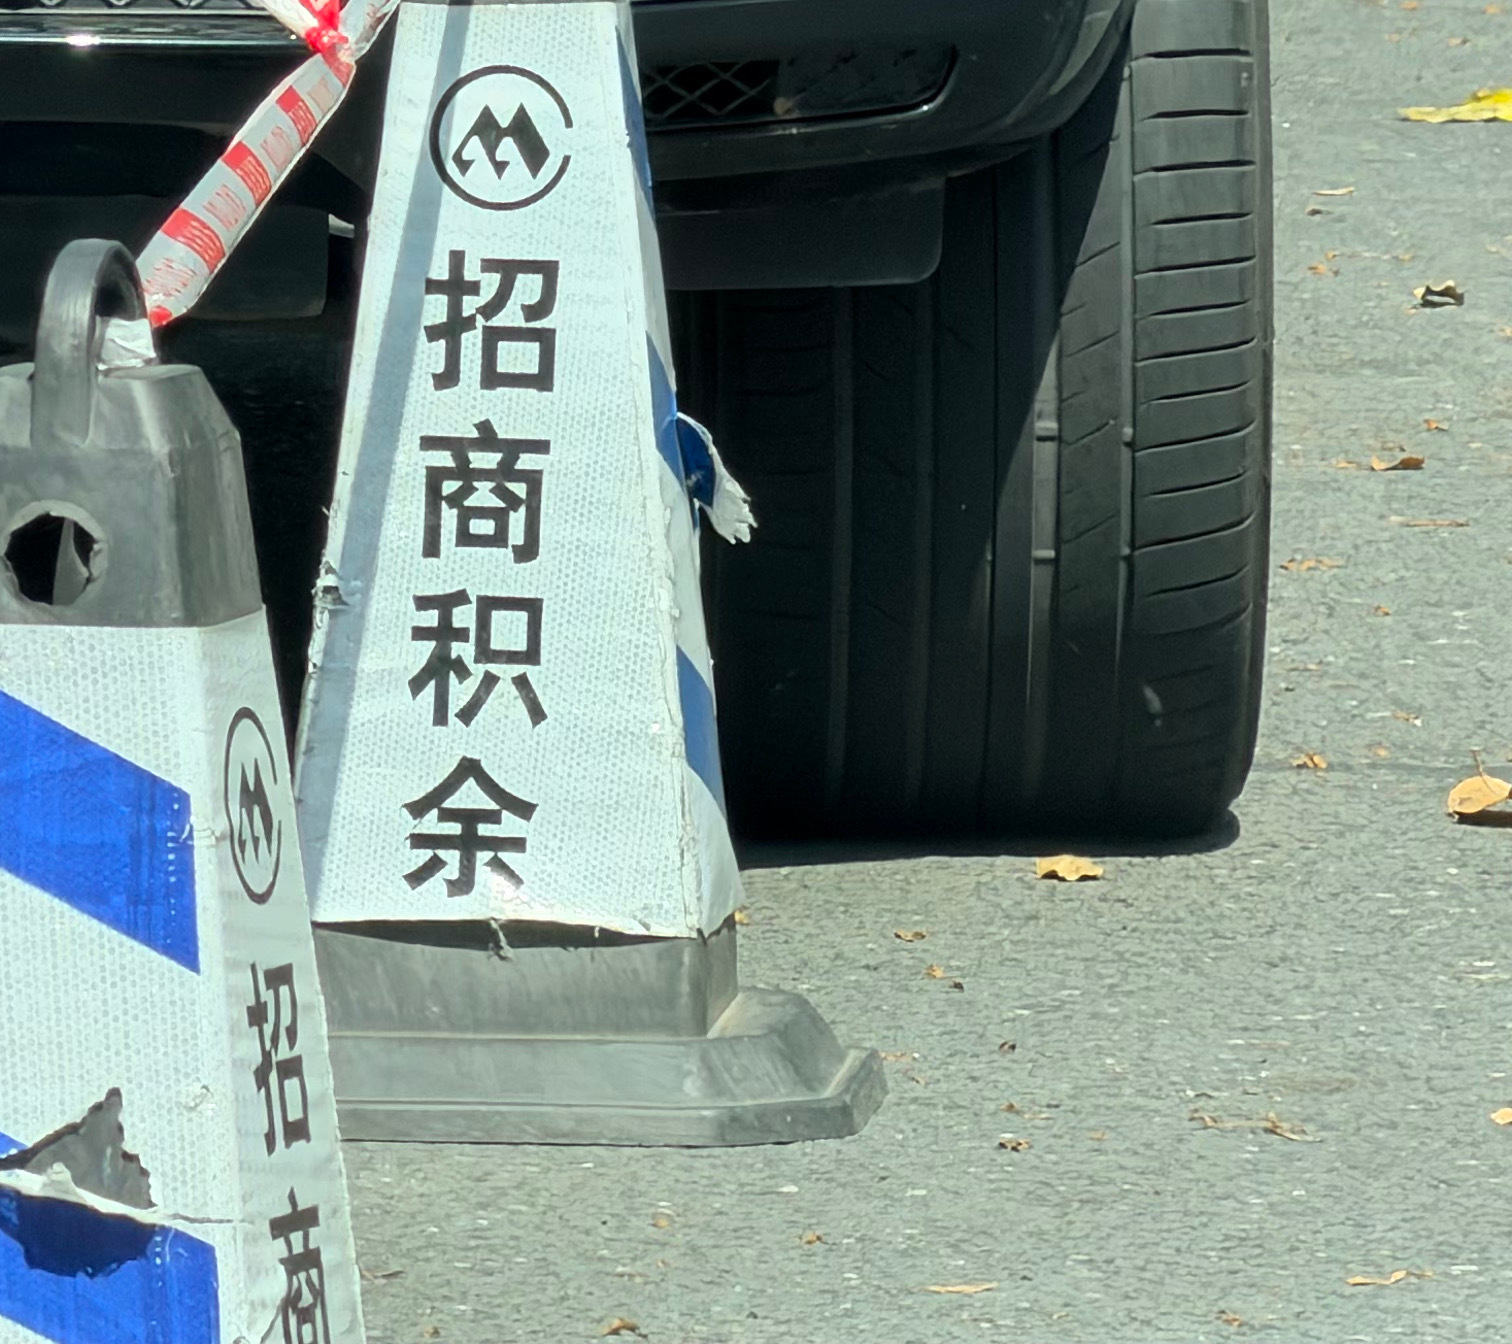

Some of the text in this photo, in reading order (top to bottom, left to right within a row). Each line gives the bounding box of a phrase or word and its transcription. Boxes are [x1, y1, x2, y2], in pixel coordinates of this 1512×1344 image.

[402, 249, 561, 898] 招商积余
[246, 960, 330, 1344] 招商
